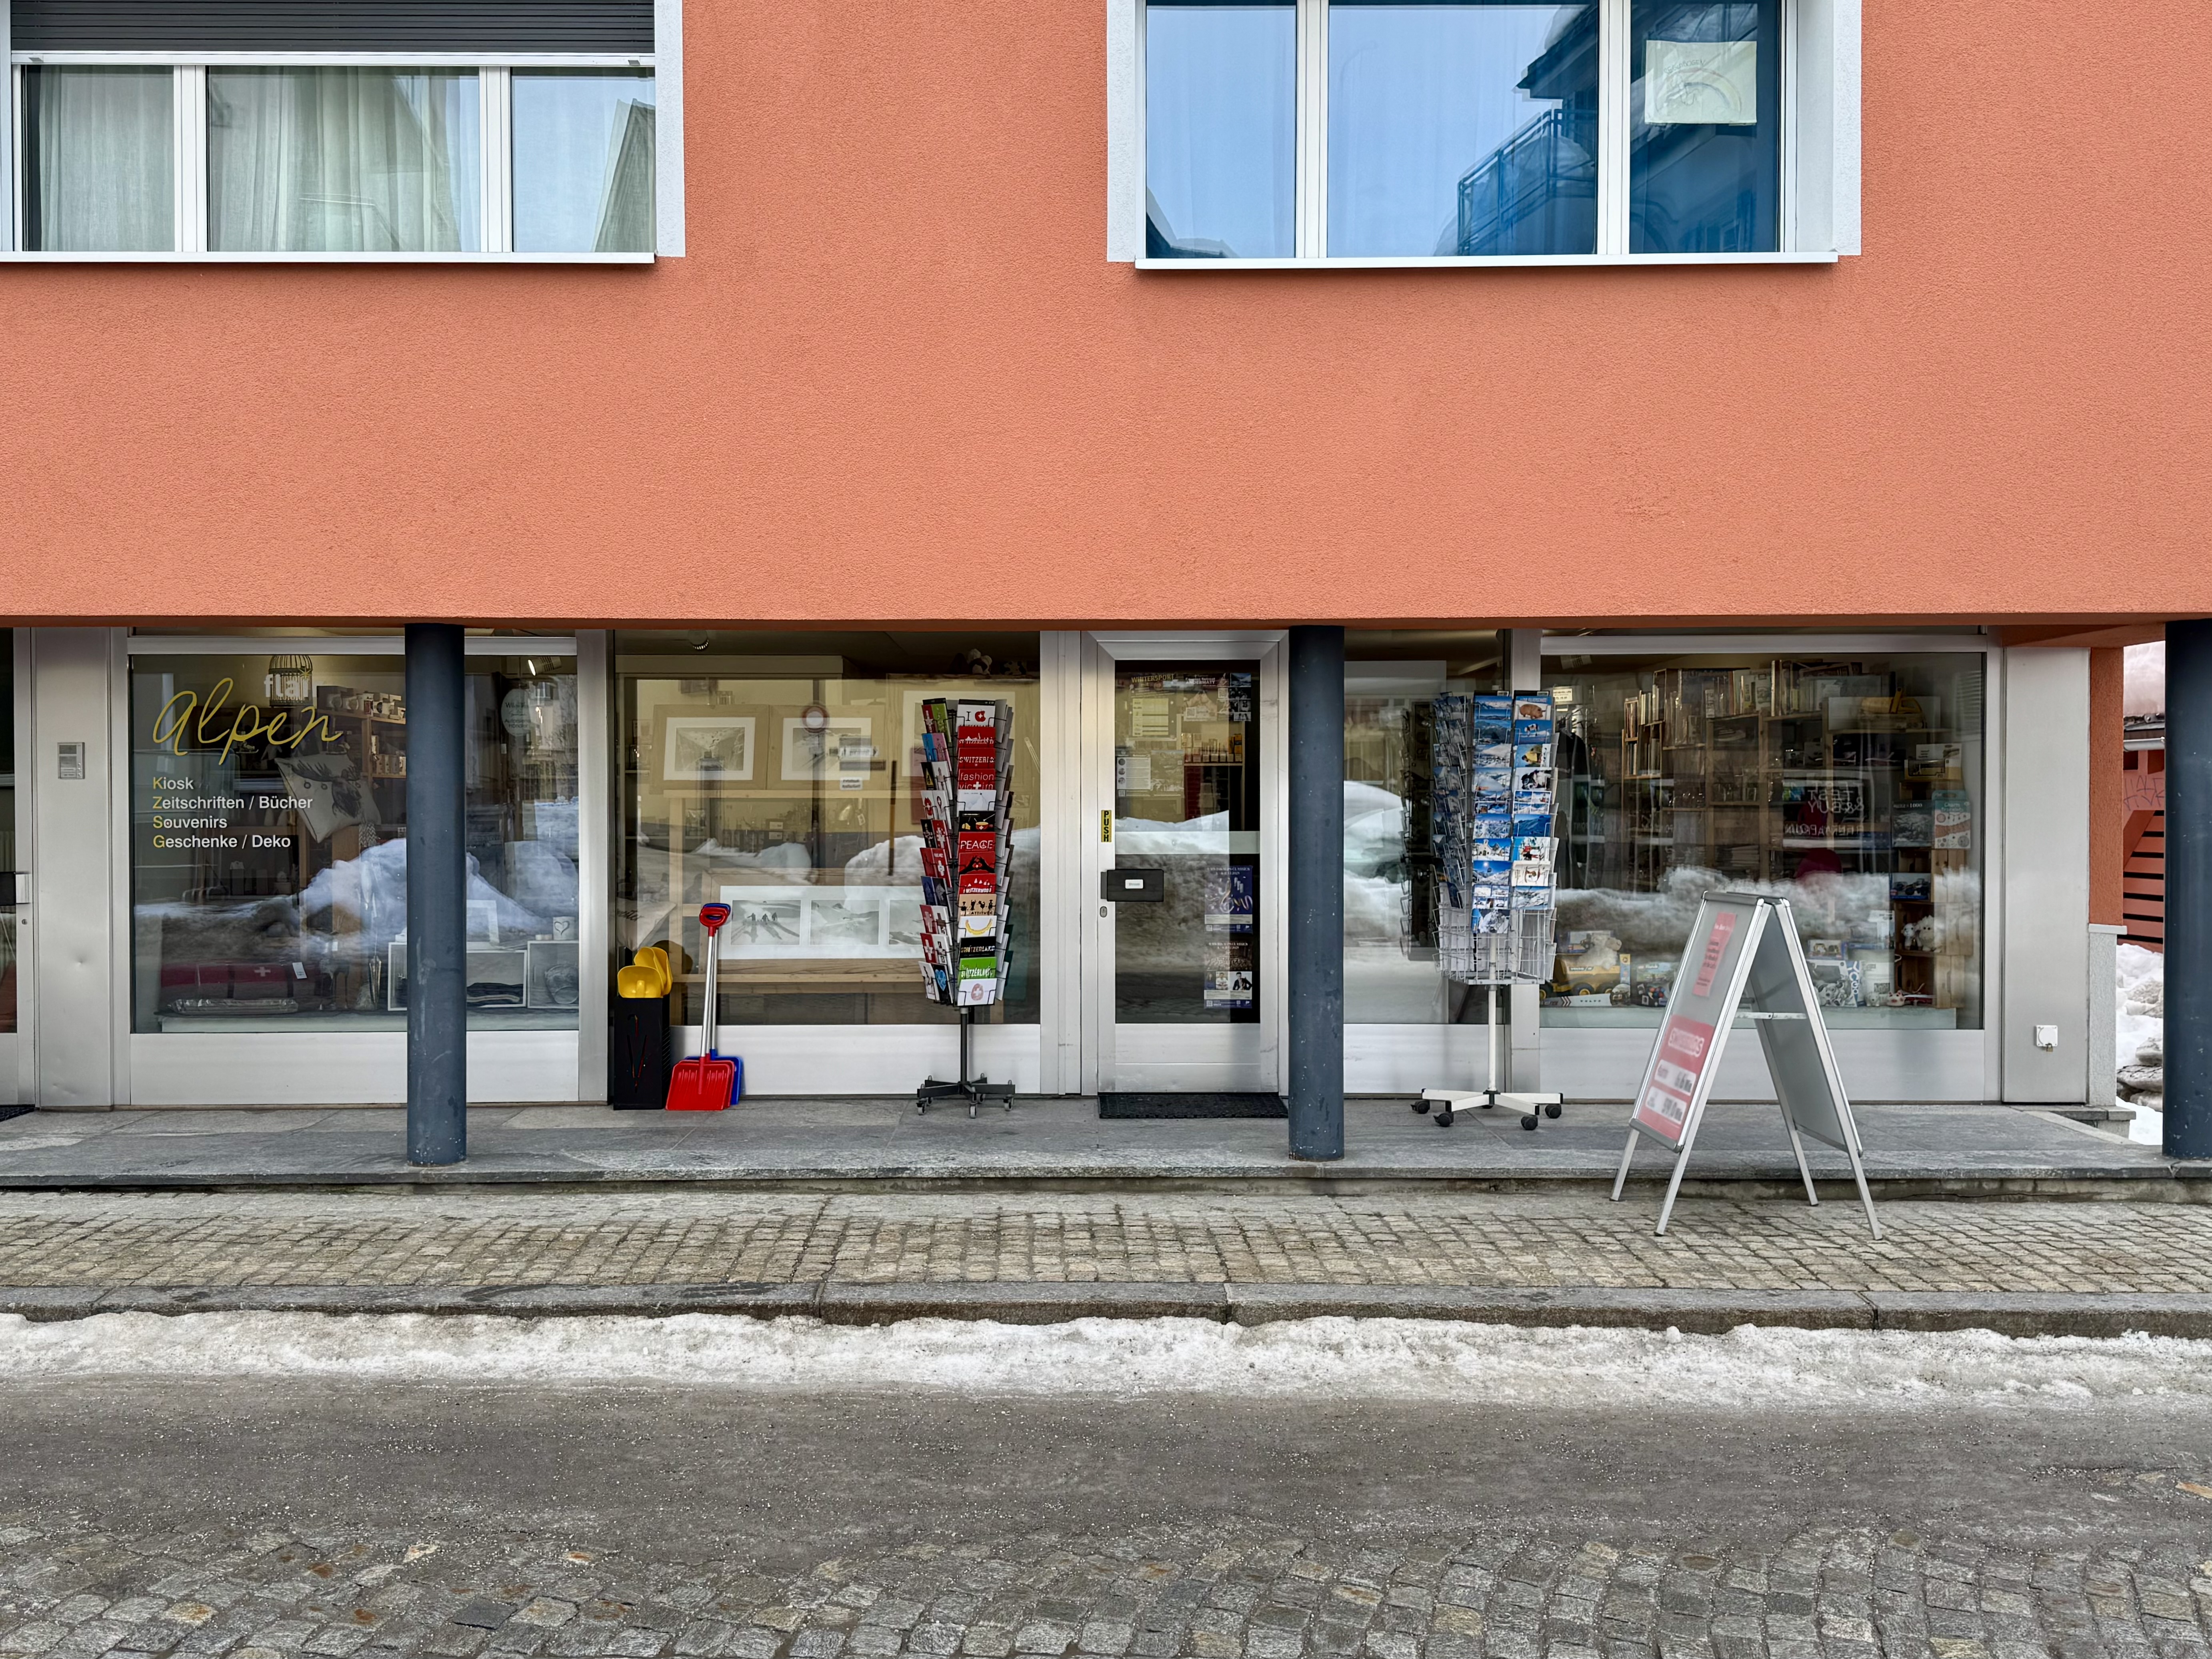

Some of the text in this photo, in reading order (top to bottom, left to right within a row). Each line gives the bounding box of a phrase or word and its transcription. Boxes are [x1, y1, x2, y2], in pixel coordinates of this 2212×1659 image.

[960, 772, 994, 780] fashion
[153, 777, 194, 790] Kiosk
[152, 795, 313, 810] Zeitschriften / Bücher
[153, 815, 228, 828] Souvenirs
[153, 834, 291, 849] Geschenke / Deko
[960, 840, 993, 849] PEACE
